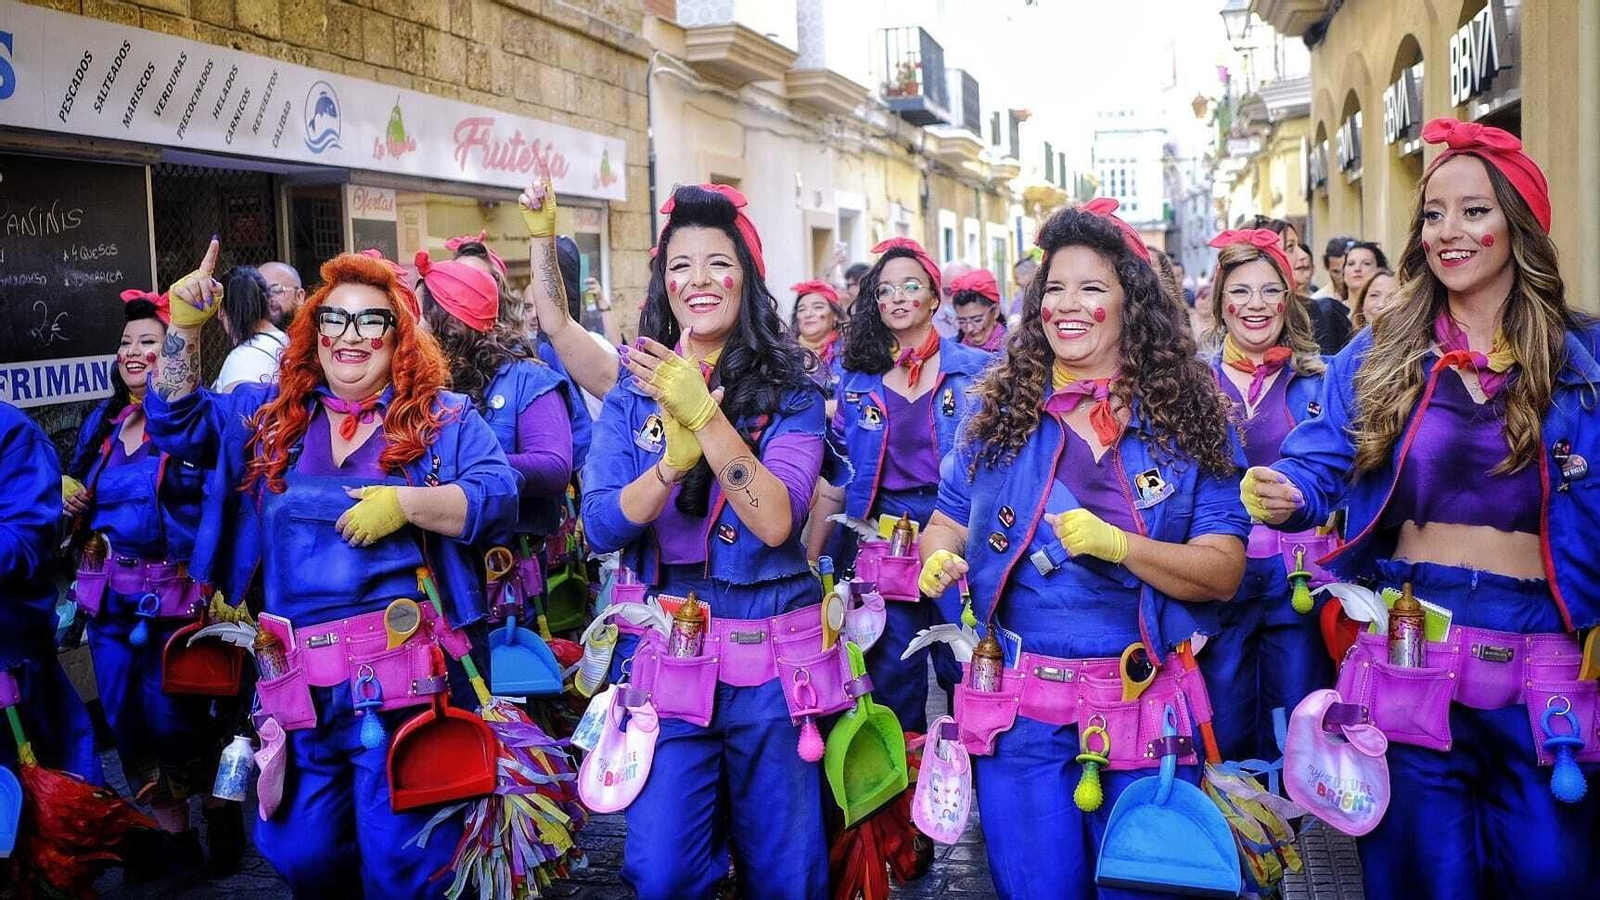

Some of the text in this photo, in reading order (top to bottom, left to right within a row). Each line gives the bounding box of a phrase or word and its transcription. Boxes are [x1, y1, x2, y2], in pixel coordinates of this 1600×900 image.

[59, 50, 93, 124] PESCADOS
[94, 40, 131, 114] SALTEADOS
[154, 51, 188, 117] VERDURAS
[1450, 0, 1500, 108] BBVA
[122, 61, 155, 129] MARISCOS
[177, 58, 214, 140] PRECOCINADOS
[213, 64, 239, 119] HELADOS
[225, 87, 252, 145] CARNICOS
[252, 69, 279, 135] REVUELTOS
[272, 100, 292, 149] CALIDAD
[1383, 68, 1411, 145] BBVA
